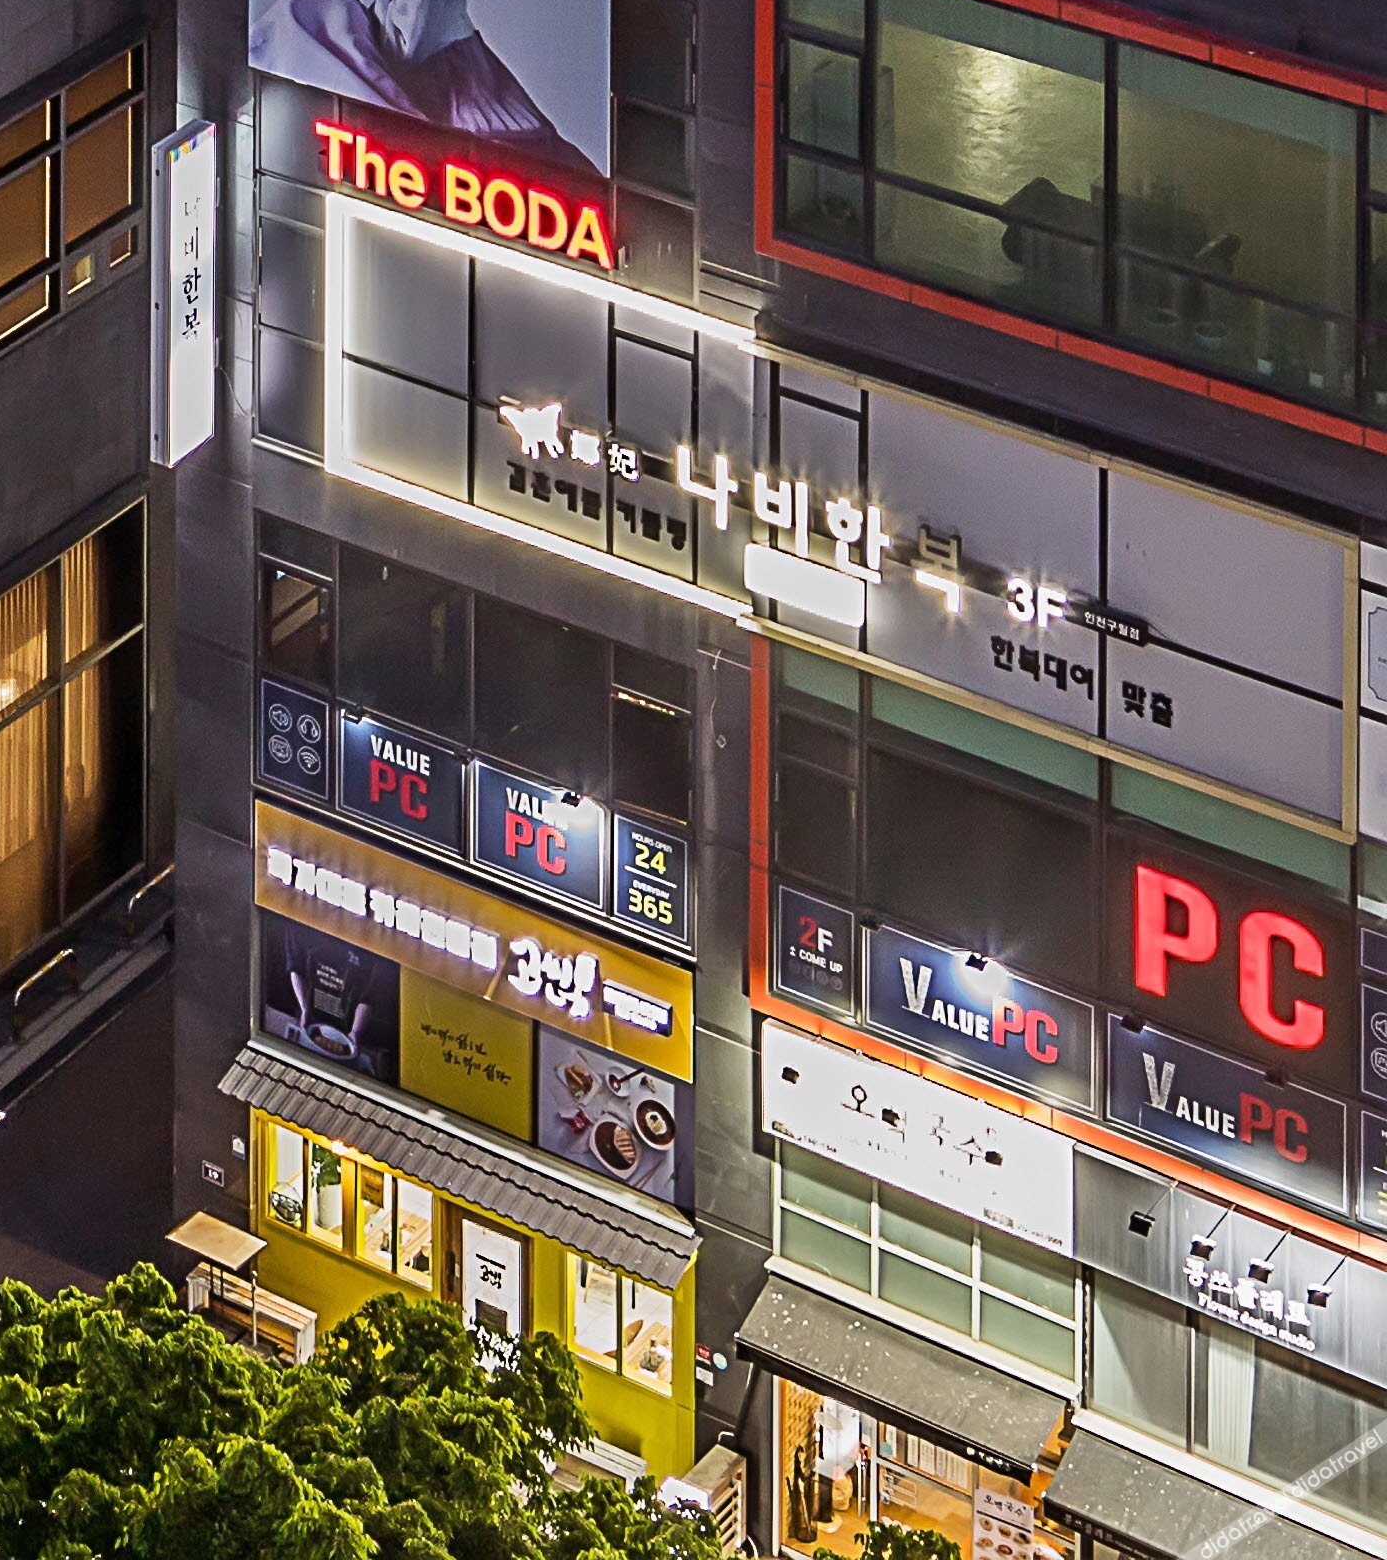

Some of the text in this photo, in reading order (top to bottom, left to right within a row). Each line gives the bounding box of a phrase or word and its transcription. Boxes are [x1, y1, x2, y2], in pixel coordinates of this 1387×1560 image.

[315, 121, 614, 270] The BODA
[676, 444, 962, 614] 나비한복
[1007, 576, 1067, 628] 3F
[991, 634, 1094, 701] 한복대여
[370, 734, 430, 776] VALUE
[369, 758, 428, 820] PC
[506, 787, 568, 831] VAL
[505, 809, 566, 876] PC
[635, 842, 667, 875] 24
[628, 887, 673, 925] 365
[799, 915, 833, 953] 2F
[799, 949, 843, 974] COME UP
[1135, 864, 1325, 1049] PC
[900, 957, 1059, 1064] VALUE PC
[1142, 1052, 1309, 1163] VALUE PC
